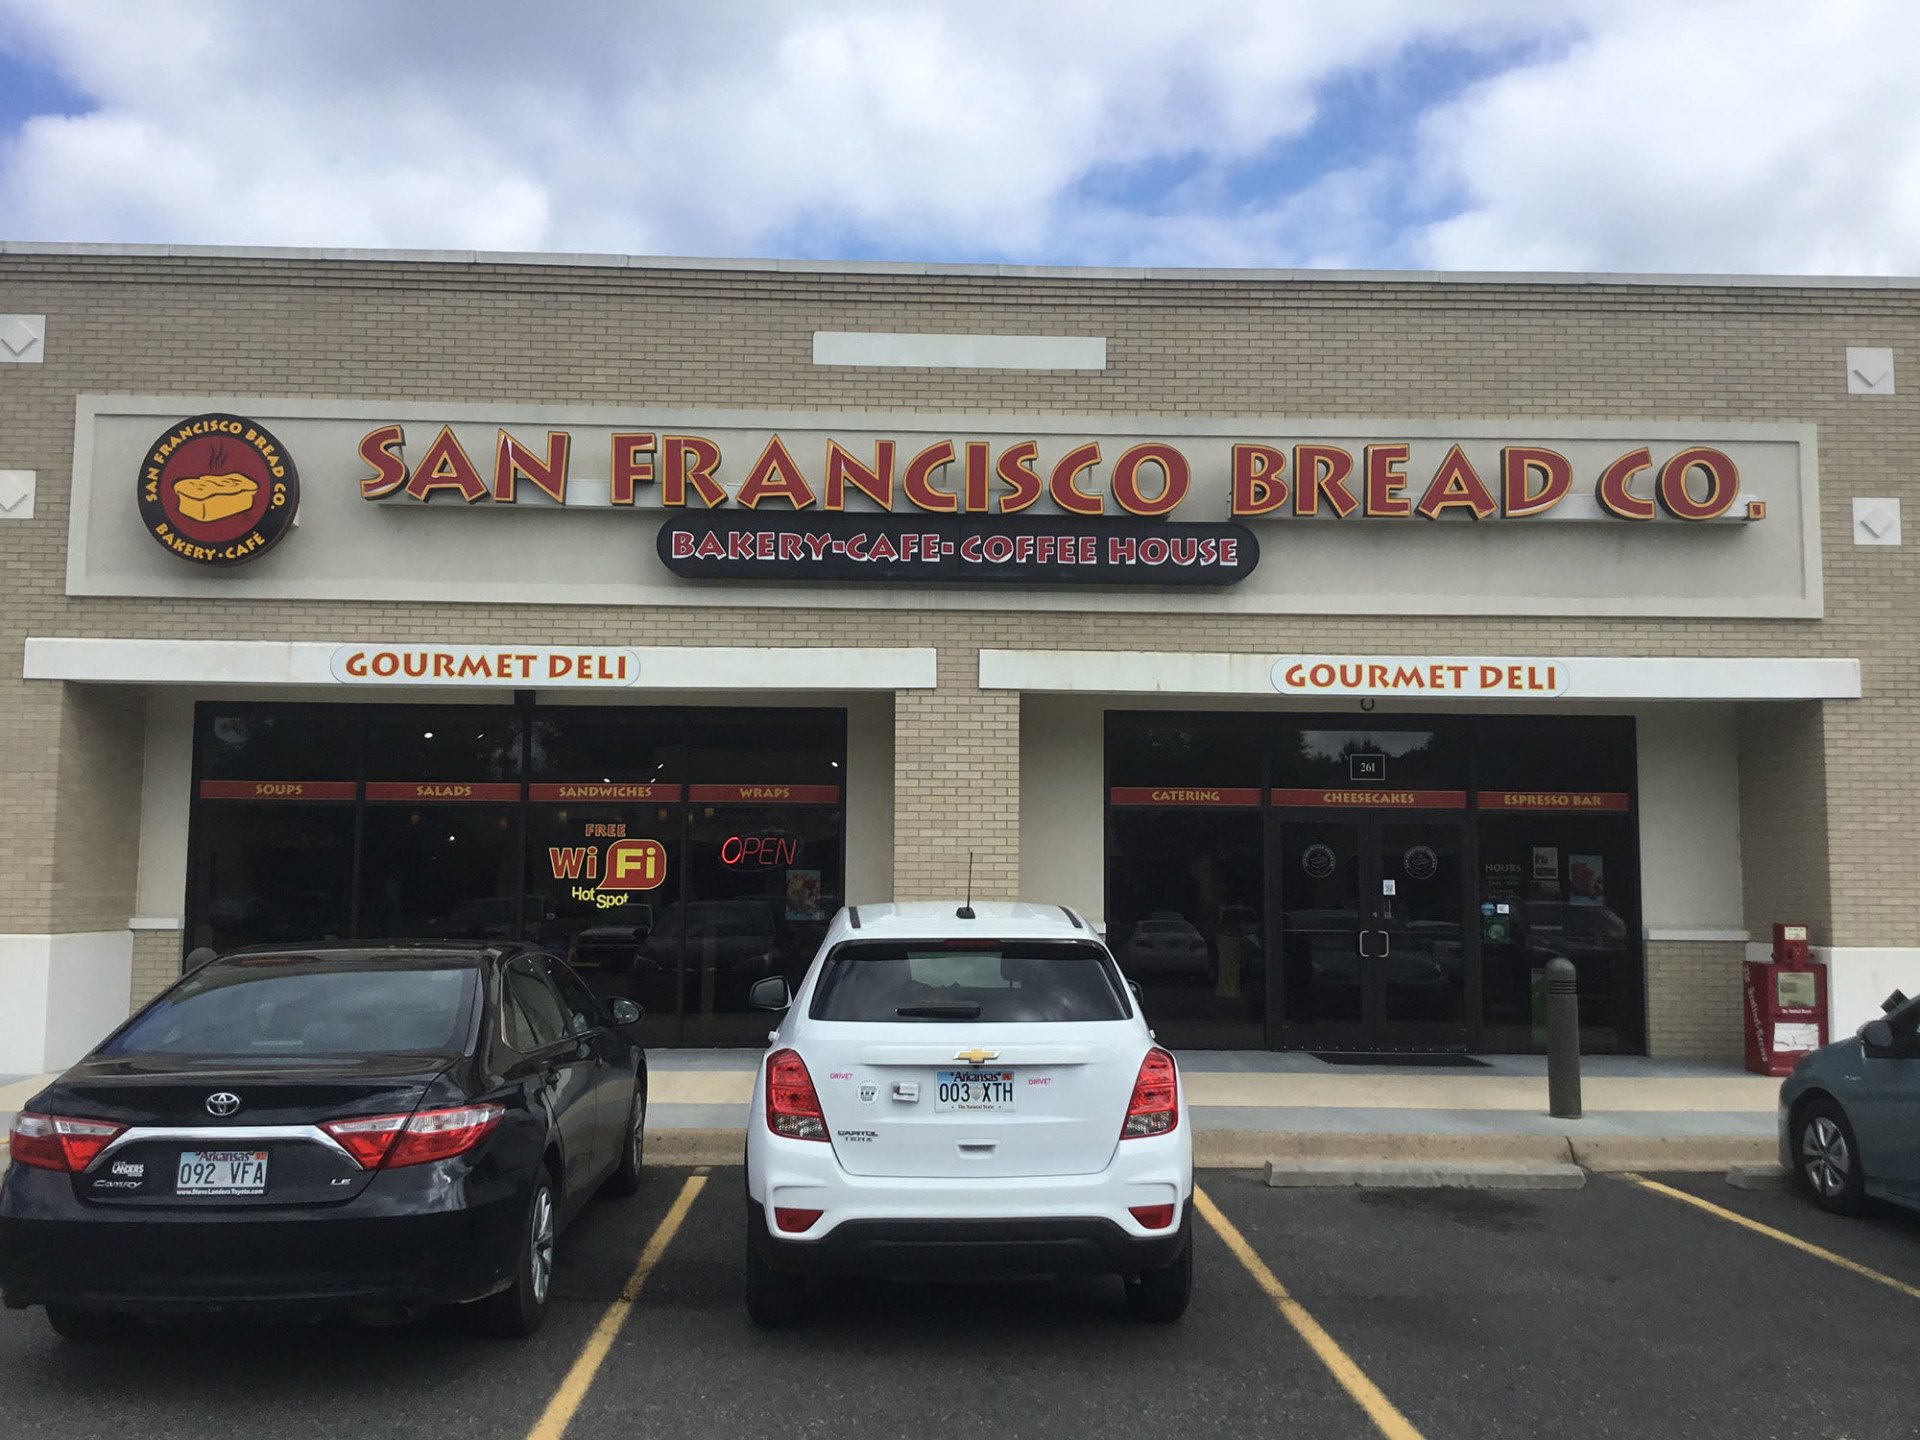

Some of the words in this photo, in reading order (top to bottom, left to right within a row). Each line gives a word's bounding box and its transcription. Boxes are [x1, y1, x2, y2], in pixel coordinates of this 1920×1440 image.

[146, 467, 160, 502] SAN
[153, 420, 243, 464] FRANCISCO
[245, 428, 285, 478] BREAD
[270, 483, 287, 509] CO.
[357, 425, 569, 502] SAN
[611, 432, 1191, 516] FRANCISCO
[1231, 444, 1573, 519] BREAD
[1599, 447, 1766, 520] CO.
[1110, 539, 1239, 566] HOUSE
[345, 652, 538, 679] GOURMET
[547, 654, 627, 680] DELI
[1284, 663, 1469, 690] GOURMET
[1479, 665, 1557, 691] DELI
[1360, 762, 1376, 773] 261
[256, 784, 303, 795] SOUPS
[416, 785, 472, 797] SALADS
[559, 786, 652, 798] SANDWICHES
[740, 788, 790, 798] WRAPS
[1151, 789, 1220, 802] CATERING
[1323, 791, 1415, 804] CHEESECAKES
[1504, 794, 1569, 806] ESPRESSO
[1573, 795, 1602, 806] BAR
[585, 823, 626, 838] FREE
[721, 836, 798, 865] OPEN
[1484, 862, 1522, 873] HOURS
[572, 886, 596, 901] Hot
[596, 892, 629, 909] Spot
[829, 1072, 853, 1080] DRIVE?
[953, 1070, 999, 1082] Arkansas
[1028, 1077, 1052, 1085] DRIVE?
[939, 1082, 971, 1102] 003
[982, 1082, 1013, 1102] XTH
[199, 1151, 250, 1162] Arkansas
[112, 1163, 144, 1174] LANDERS
[180, 1162, 216, 1185] 092
[230, 1162, 263, 1184] VFA
[330, 1178, 352, 1186] LE
